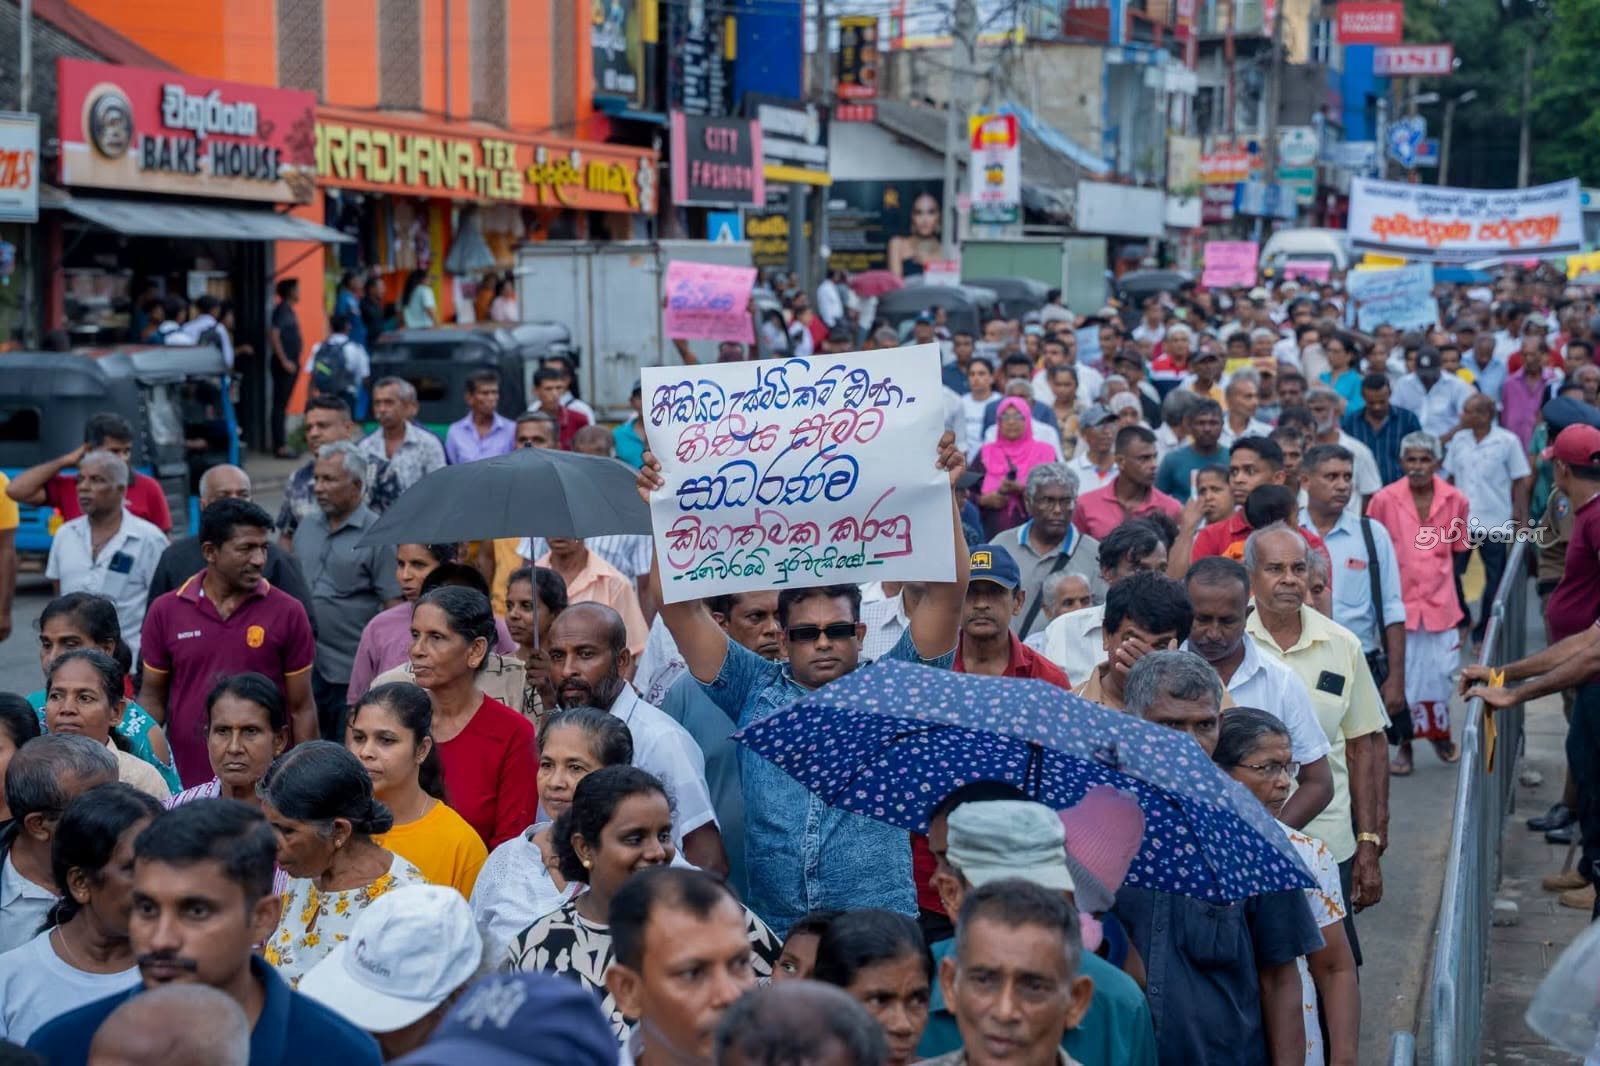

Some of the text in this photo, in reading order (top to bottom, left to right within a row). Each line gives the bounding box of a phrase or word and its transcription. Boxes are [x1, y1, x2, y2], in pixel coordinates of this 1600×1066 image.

[481, 138, 516, 170] TEX
[705, 126, 738, 154] CITY
[140, 134, 283, 182] BAKE HOUSE
[475, 167, 523, 200] TILES
[691, 160, 753, 190] FASHION
